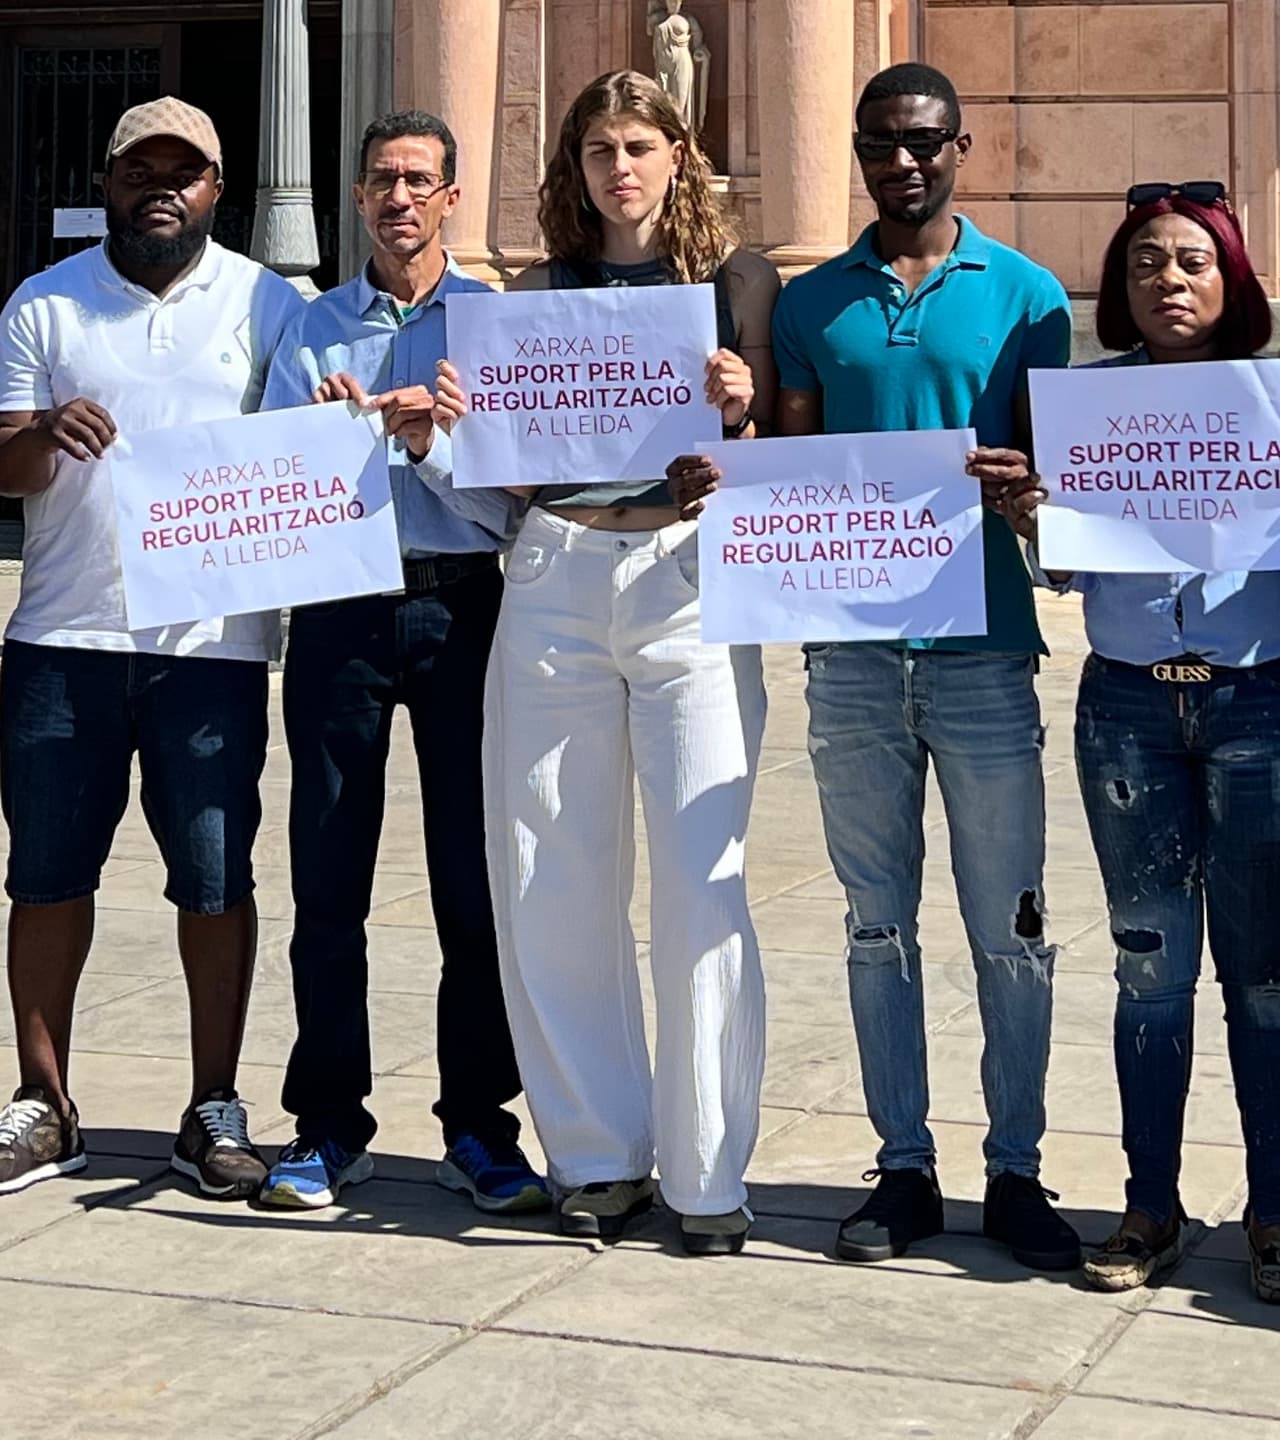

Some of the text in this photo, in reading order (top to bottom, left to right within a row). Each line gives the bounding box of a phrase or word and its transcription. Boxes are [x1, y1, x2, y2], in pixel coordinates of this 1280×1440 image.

[514, 334, 635, 358] XARXA DE
[480, 360, 675, 386] SUPORT PER LA
[471, 380, 692, 412] REGULARITZACIÓ
[527, 414, 632, 437] A LLEIDA
[1106, 412, 1240, 436] XARXA DE
[1069, 441, 1180, 465] SUPORT
[1190, 441, 1240, 461] PER
[182, 454, 306, 492] XARXA DE
[150, 476, 348, 522] SUPORT PER LA
[769, 482, 896, 507] XARXA DE
[732, 508, 937, 536] SUPORT PER LA
[1121, 499, 1238, 520] A LLEIDA
[142, 494, 364, 551] REGULARITZACIÓ
[200, 536, 308, 570] A LLEIDA
[722, 530, 953, 565] REGULARITZACIÓ
[780, 567, 892, 590] A LLEIDA
[1152, 664, 1211, 682] GUESS
